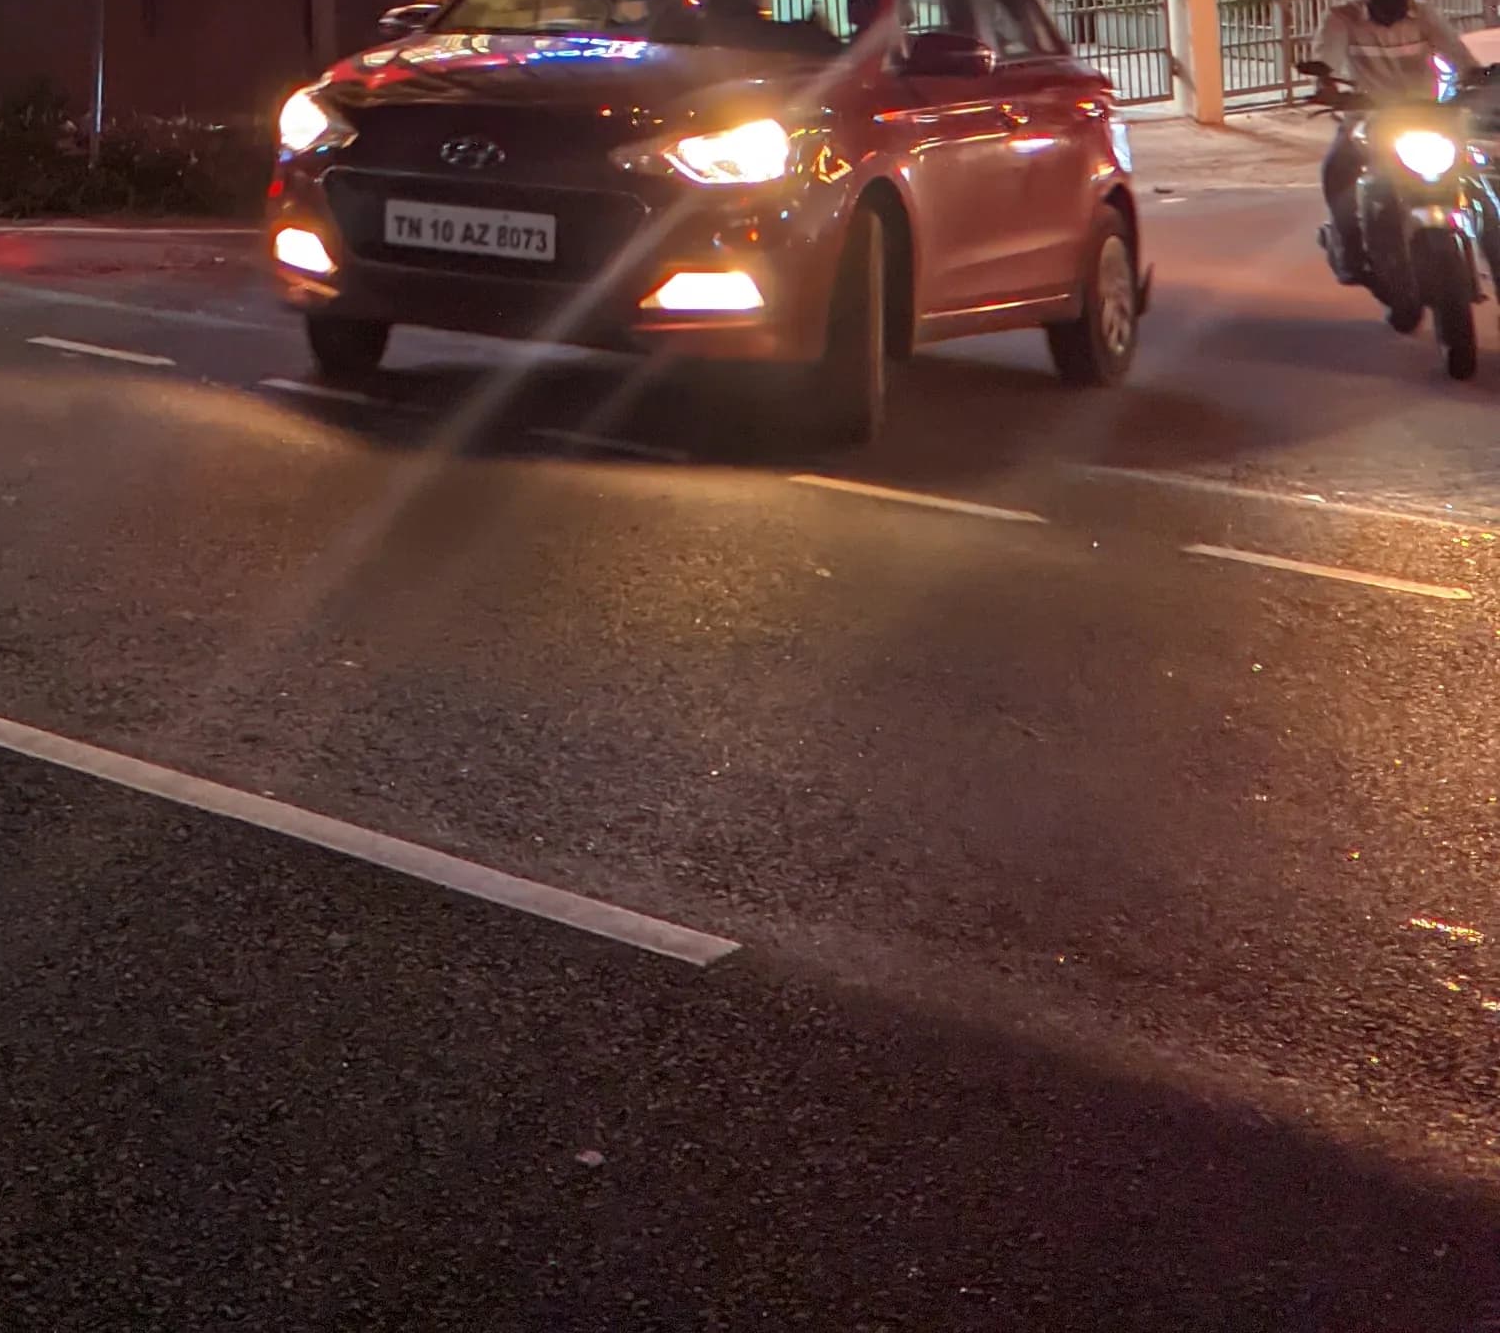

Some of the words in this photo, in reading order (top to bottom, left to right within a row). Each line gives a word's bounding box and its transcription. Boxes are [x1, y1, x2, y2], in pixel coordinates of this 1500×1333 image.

[430, 219, 455, 244] 10
[460, 223, 490, 246] AZ
[496, 225, 548, 254] 8073
